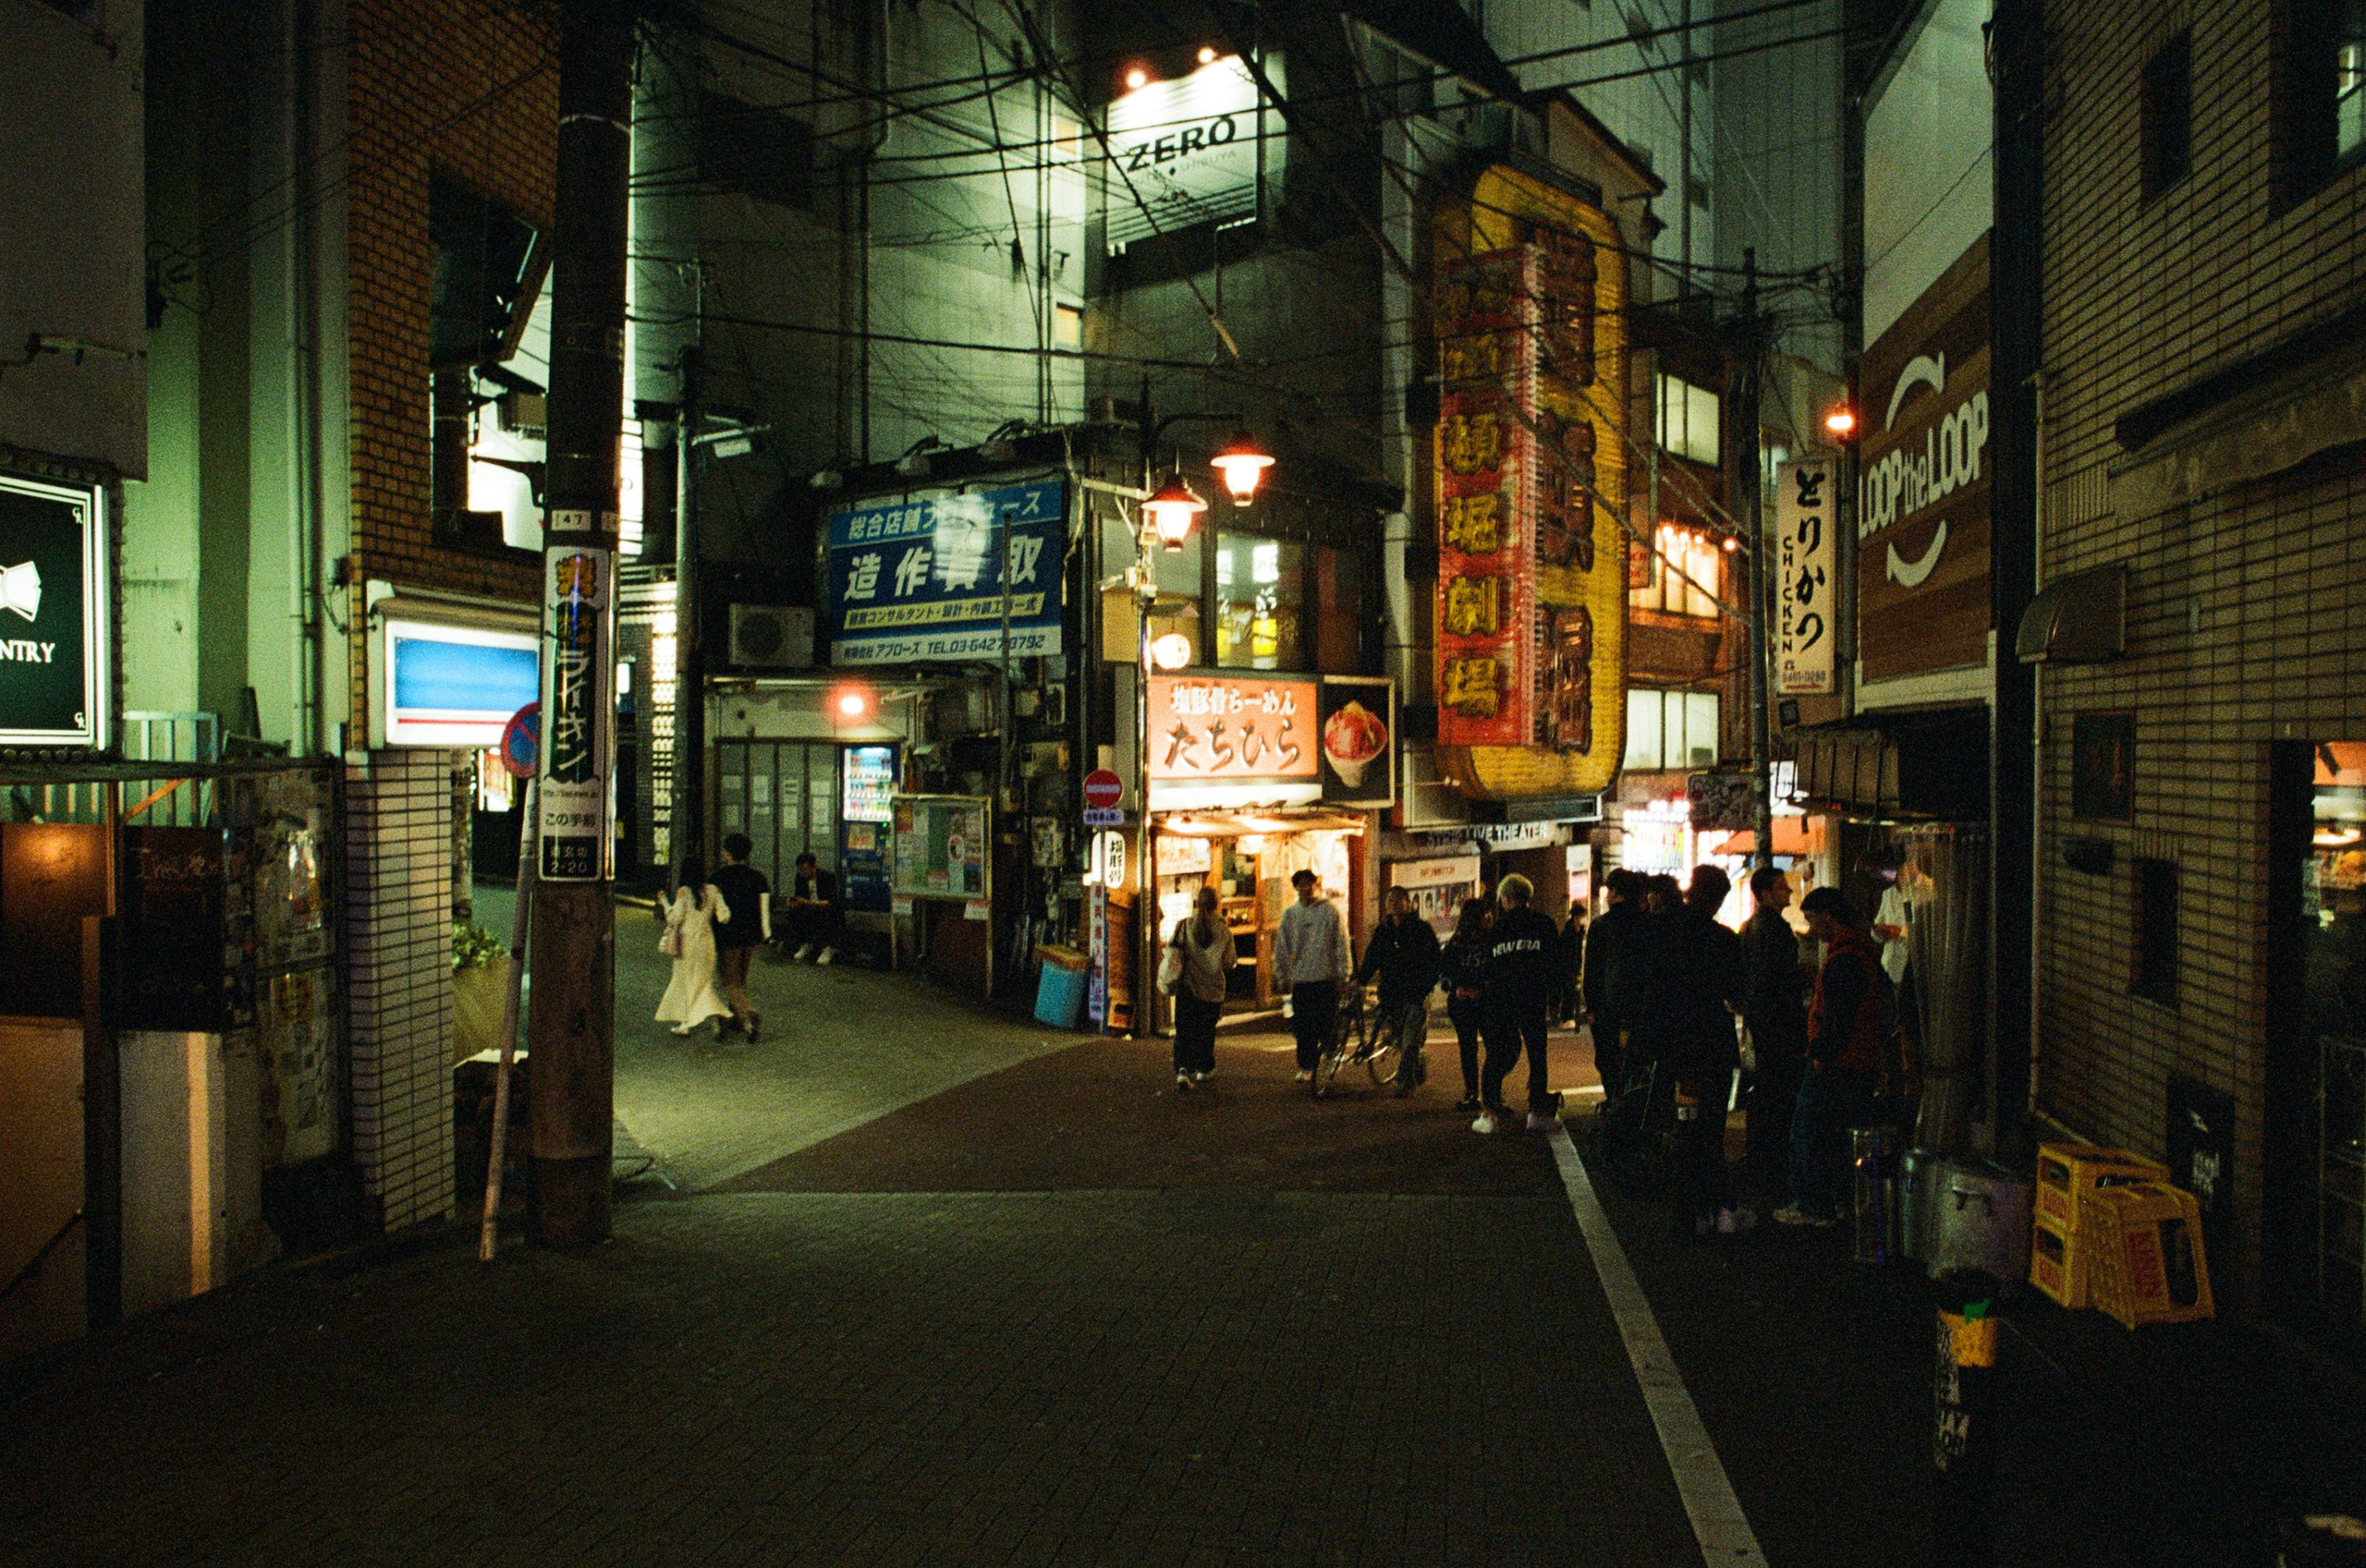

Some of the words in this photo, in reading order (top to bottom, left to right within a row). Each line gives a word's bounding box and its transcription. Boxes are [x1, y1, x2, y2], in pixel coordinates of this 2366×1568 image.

[1127, 114, 1237, 173] ZERO
[1796, 468, 1826, 652] とりかつ
[1782, 535, 1794, 652] CHICKEN
[927, 635, 1045, 654] TEL.03-64279792
[1170, 685, 1298, 715] 塩豚骨らーめん
[545, 813, 596, 828] この手前
[1496, 822, 1548, 842] THEATER
